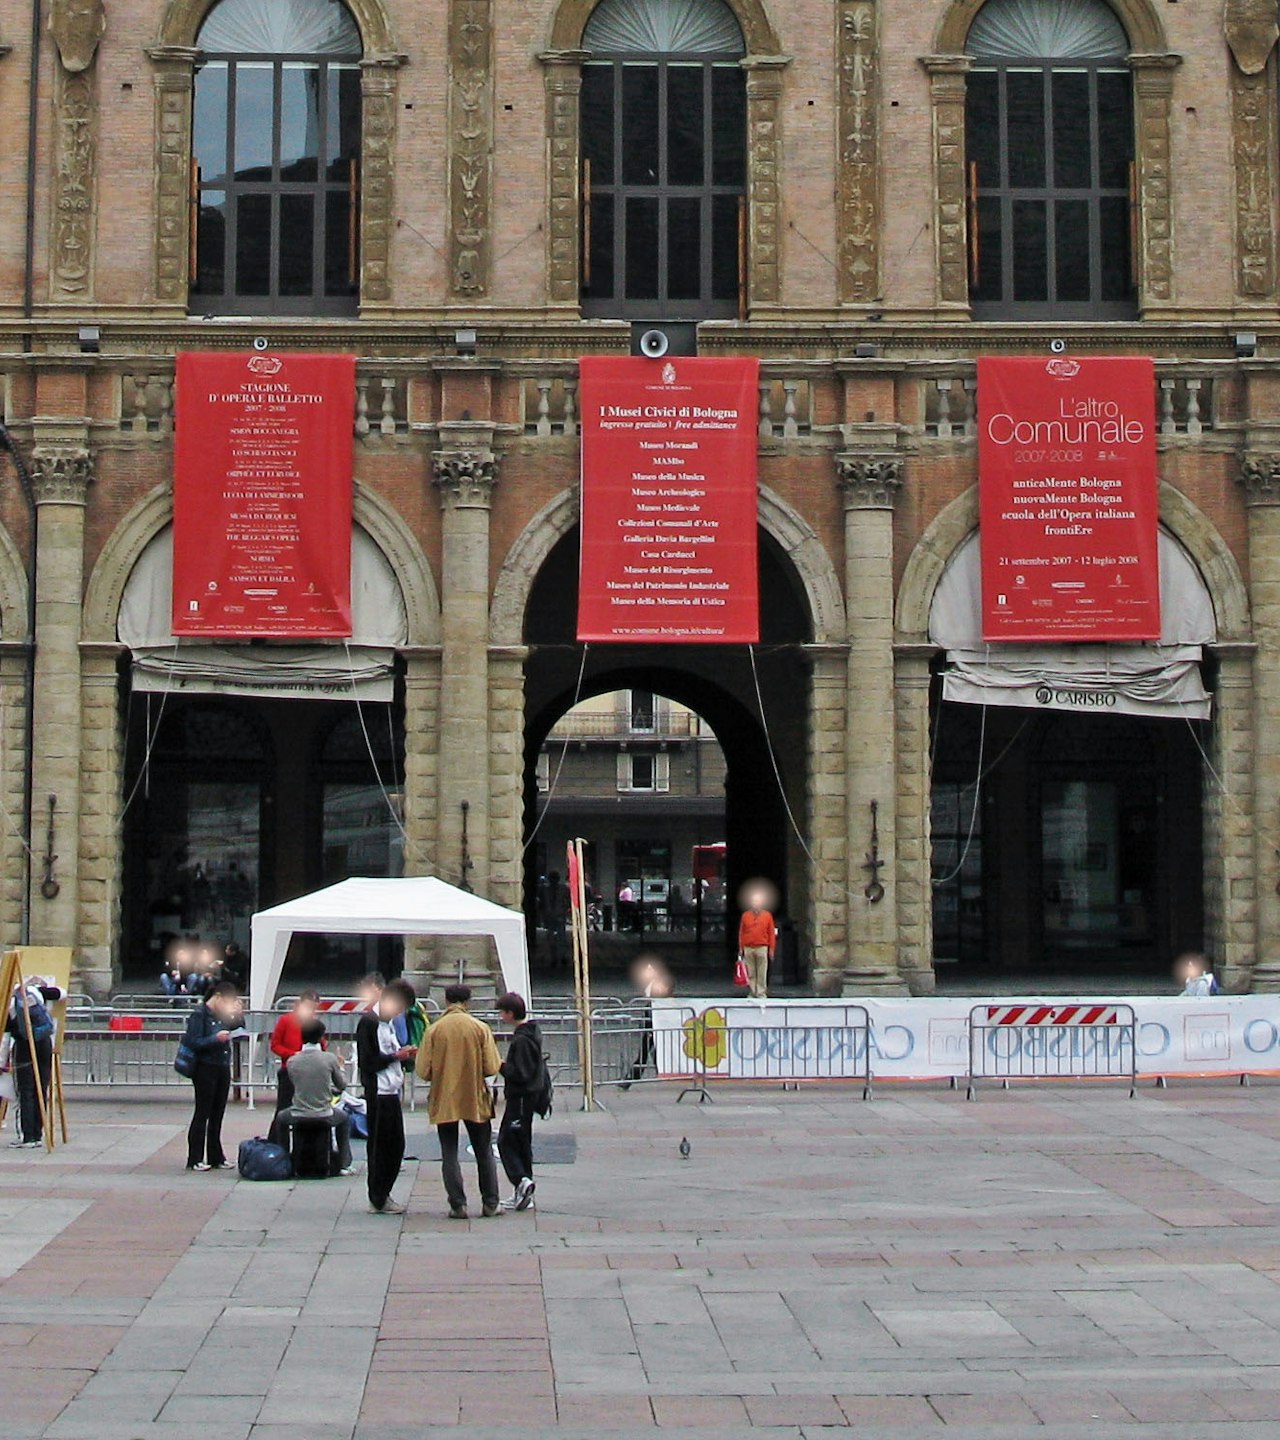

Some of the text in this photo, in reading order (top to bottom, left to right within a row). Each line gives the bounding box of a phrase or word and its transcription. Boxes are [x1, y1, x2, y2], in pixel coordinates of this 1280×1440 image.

[240, 383, 291, 392] STAGIONE
[258, 394, 265, 402] E
[268, 394, 322, 403] BALLETTO
[600, 406, 738, 419] I Musei Civici di Bologna
[1060, 397, 1118, 418] L'altro
[988, 413, 1144, 445] Comunale
[665, 441, 698, 449] Morandi
[632, 473, 705, 481] Museo della Musica
[1013, 478, 1122, 490] anticaMente Bologna
[658, 489, 705, 497] Archeologico
[1013, 493, 1122, 505] nuovaMente Bologna
[1002, 509, 1135, 522] scuola dell'Opera italiana
[1045, 524, 1093, 535] frontiEre
[999, 556, 1138, 567] 21 settembre 2007 12 luglio 2008
[663, 567, 713, 575] Risorgimento
[702, 598, 725, 606] Ustica
[1056, 690, 1116, 707] CARISBO
